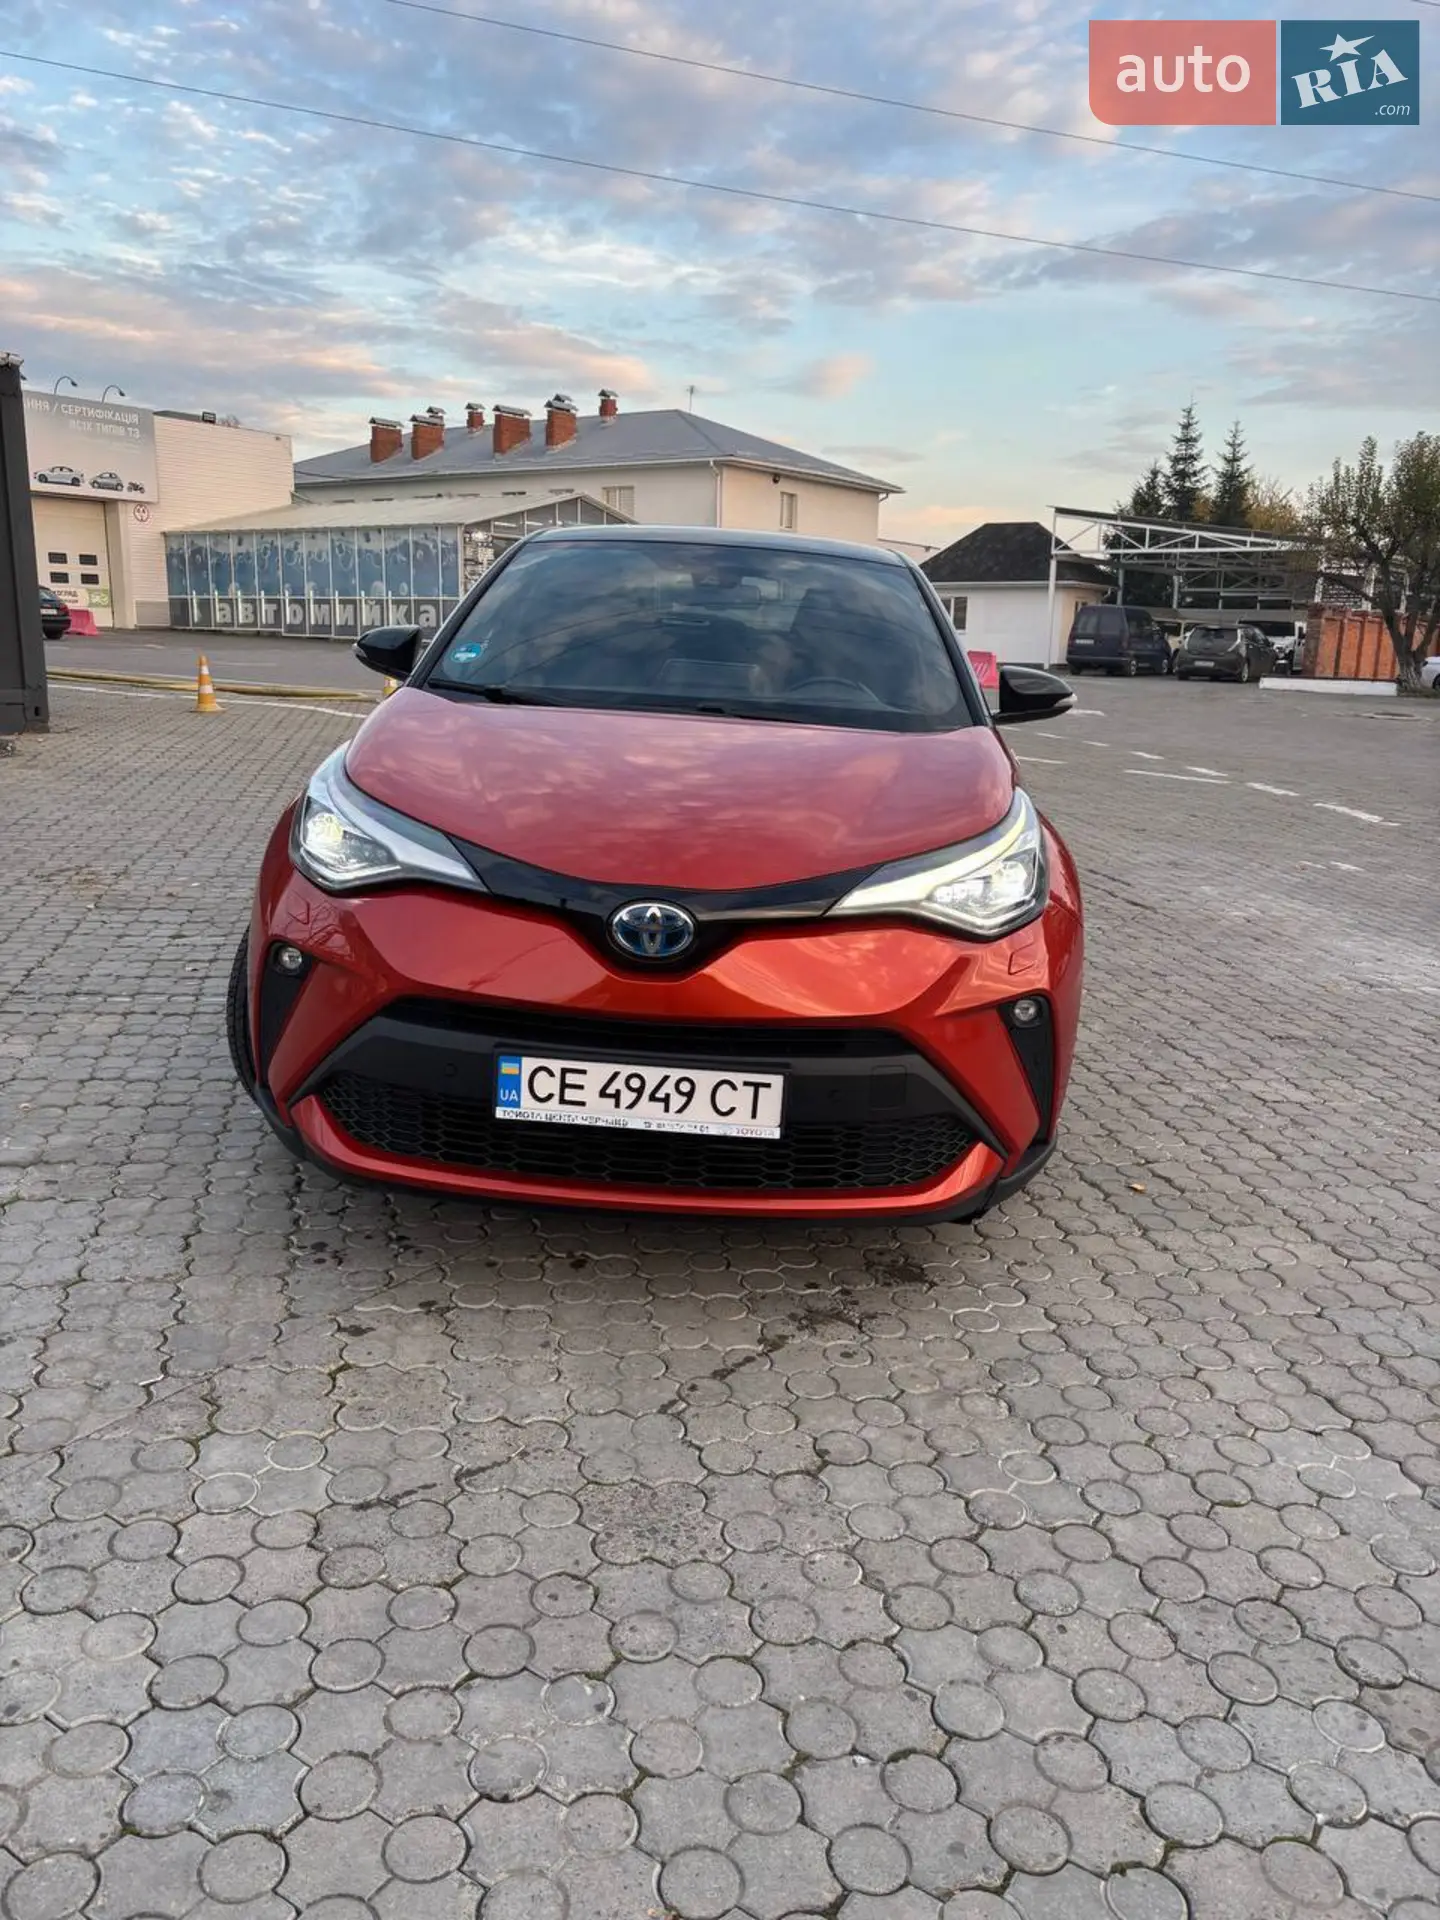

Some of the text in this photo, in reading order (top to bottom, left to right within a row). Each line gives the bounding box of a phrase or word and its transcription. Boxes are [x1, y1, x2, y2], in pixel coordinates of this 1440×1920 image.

[24, 397, 50, 412] ННЯ
[61, 403, 139, 425] СЕРТИФІКАЦІЯ
[216, 600, 436, 627] автомийка
[500, 1065, 772, 1120] UA CE 4949 CT
